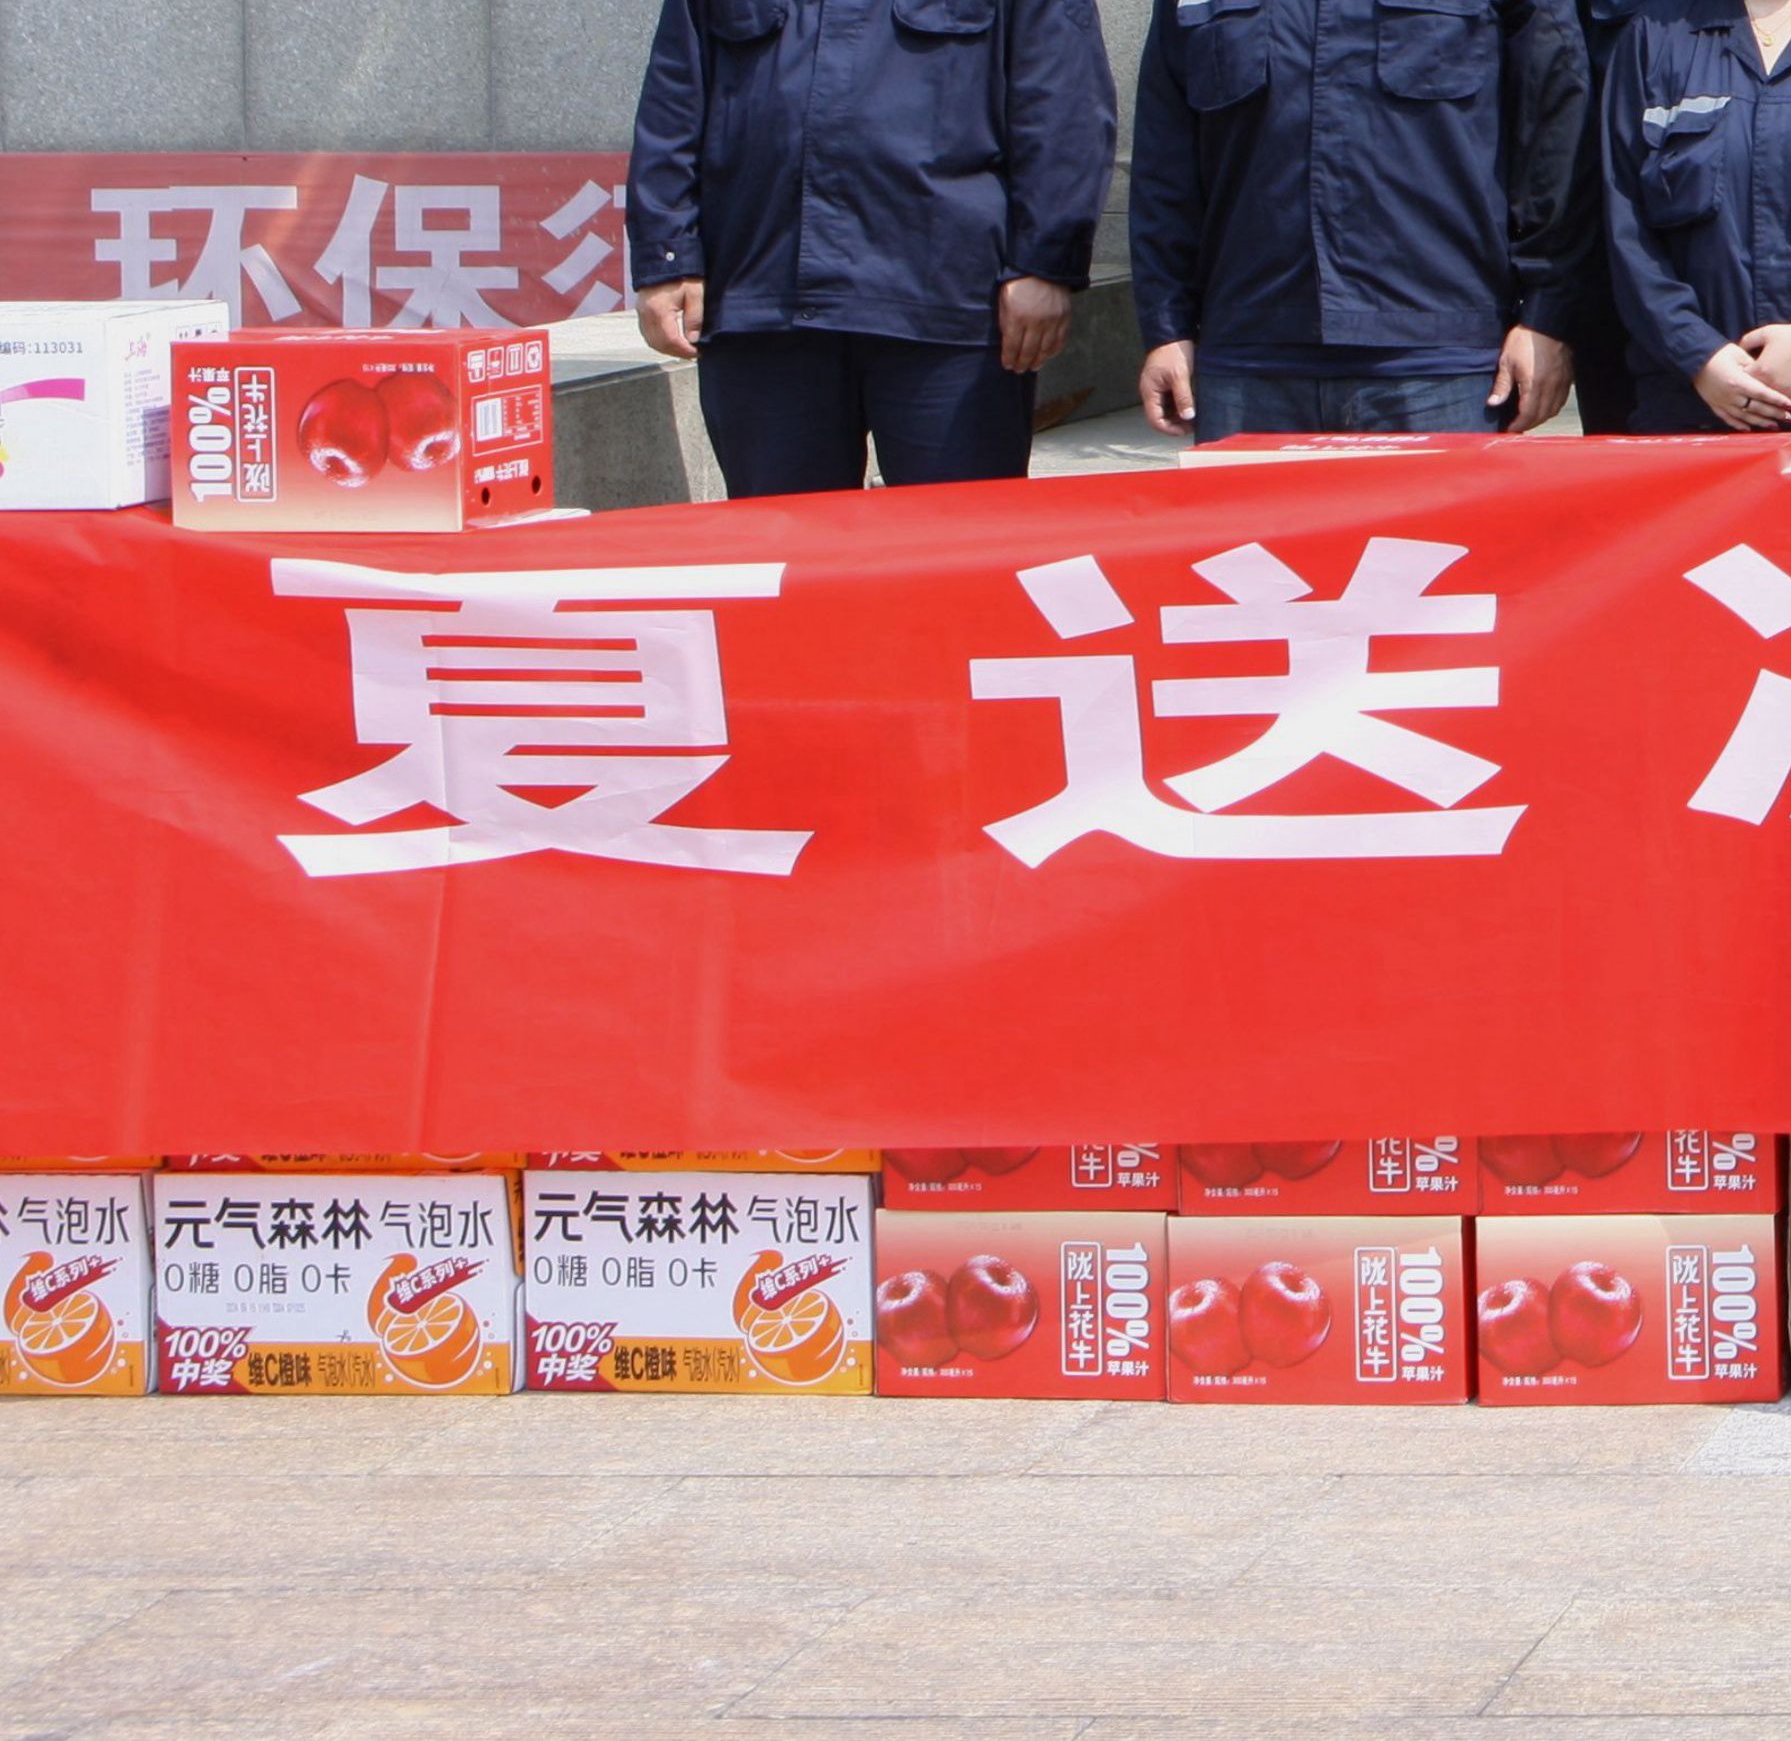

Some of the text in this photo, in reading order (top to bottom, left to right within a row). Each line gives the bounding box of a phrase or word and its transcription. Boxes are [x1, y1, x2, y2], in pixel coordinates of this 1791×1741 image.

[188, 386, 233, 503] 100%
[164, 1197, 373, 1250] 元气森林
[380, 1199, 494, 1250] 气泡水
[533, 1191, 740, 1244] 元气森林
[746, 1195, 860, 1244] 气泡水
[1067, 1251, 1095, 1368] 陇上花牛
[1105, 1242, 1150, 1357] 100%
[1361, 1256, 1390, 1375] 陇上花牛
[1400, 1246, 1445, 1363] 100%
[1673, 1254, 1701, 1372] 陇上花牛
[1711, 1244, 1757, 1360] 100%
[164, 1326, 249, 1357] 100%
[531, 1324, 614, 1354] 100%
[613, 1347, 677, 1381] 维C橙味
[171, 1358, 235, 1391] 中奖
[247, 1351, 312, 1388] 维C橙味
[537, 1354, 600, 1386] 中奖
